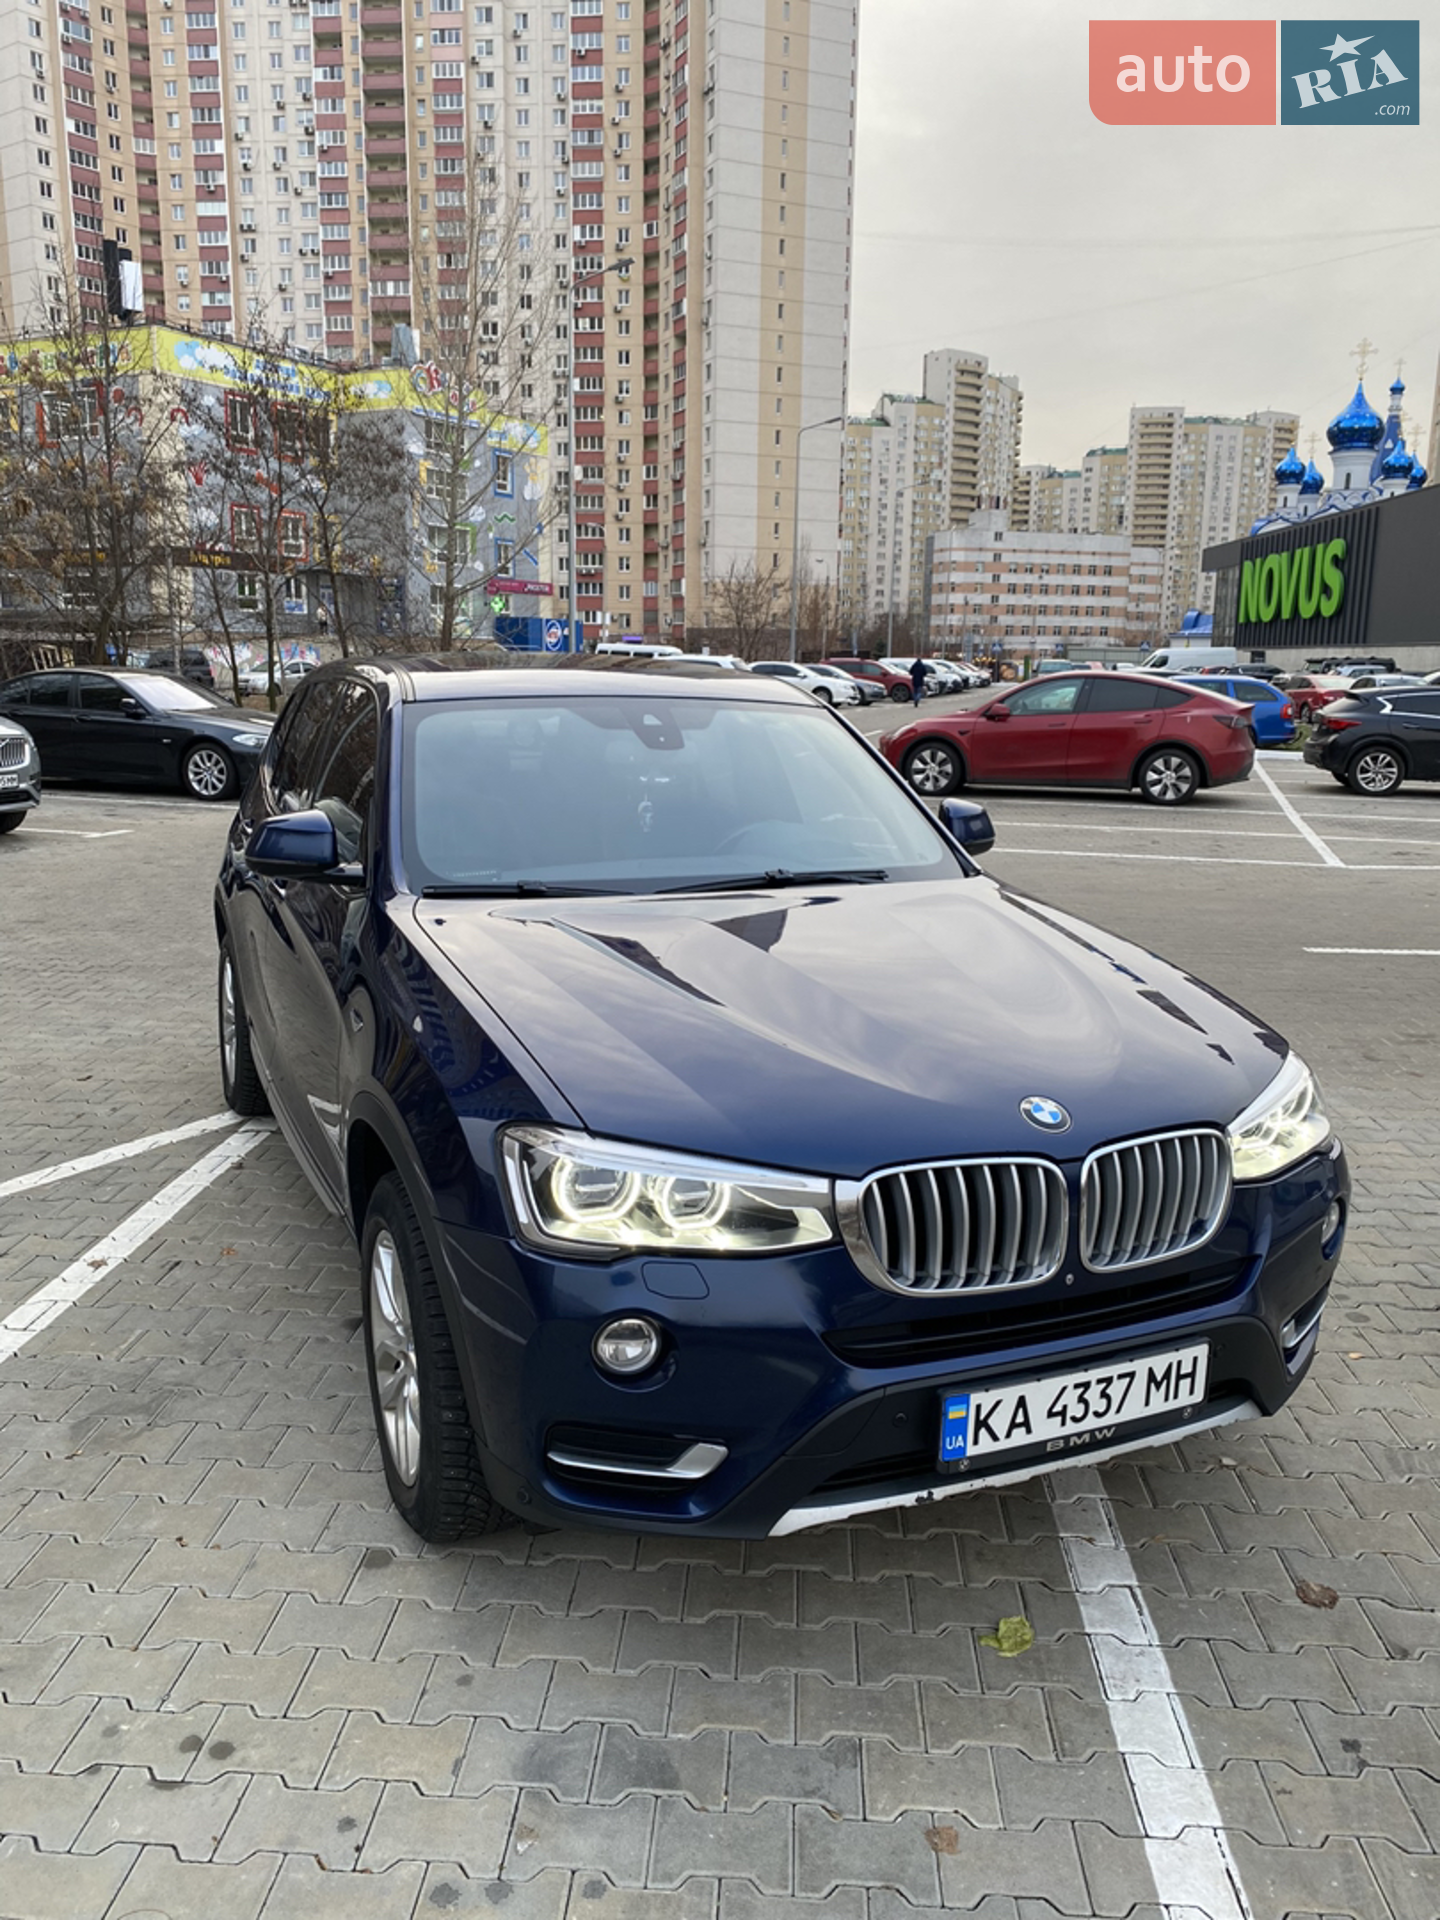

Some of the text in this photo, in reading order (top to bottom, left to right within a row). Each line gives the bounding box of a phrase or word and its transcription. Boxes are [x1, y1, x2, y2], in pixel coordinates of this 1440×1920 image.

[1239, 538, 1347, 624] NOVUS
[972, 1356, 1198, 1446] KA 4337 MH
[945, 1434, 965, 1449] UA
[1046, 1426, 1116, 1452] BMW
